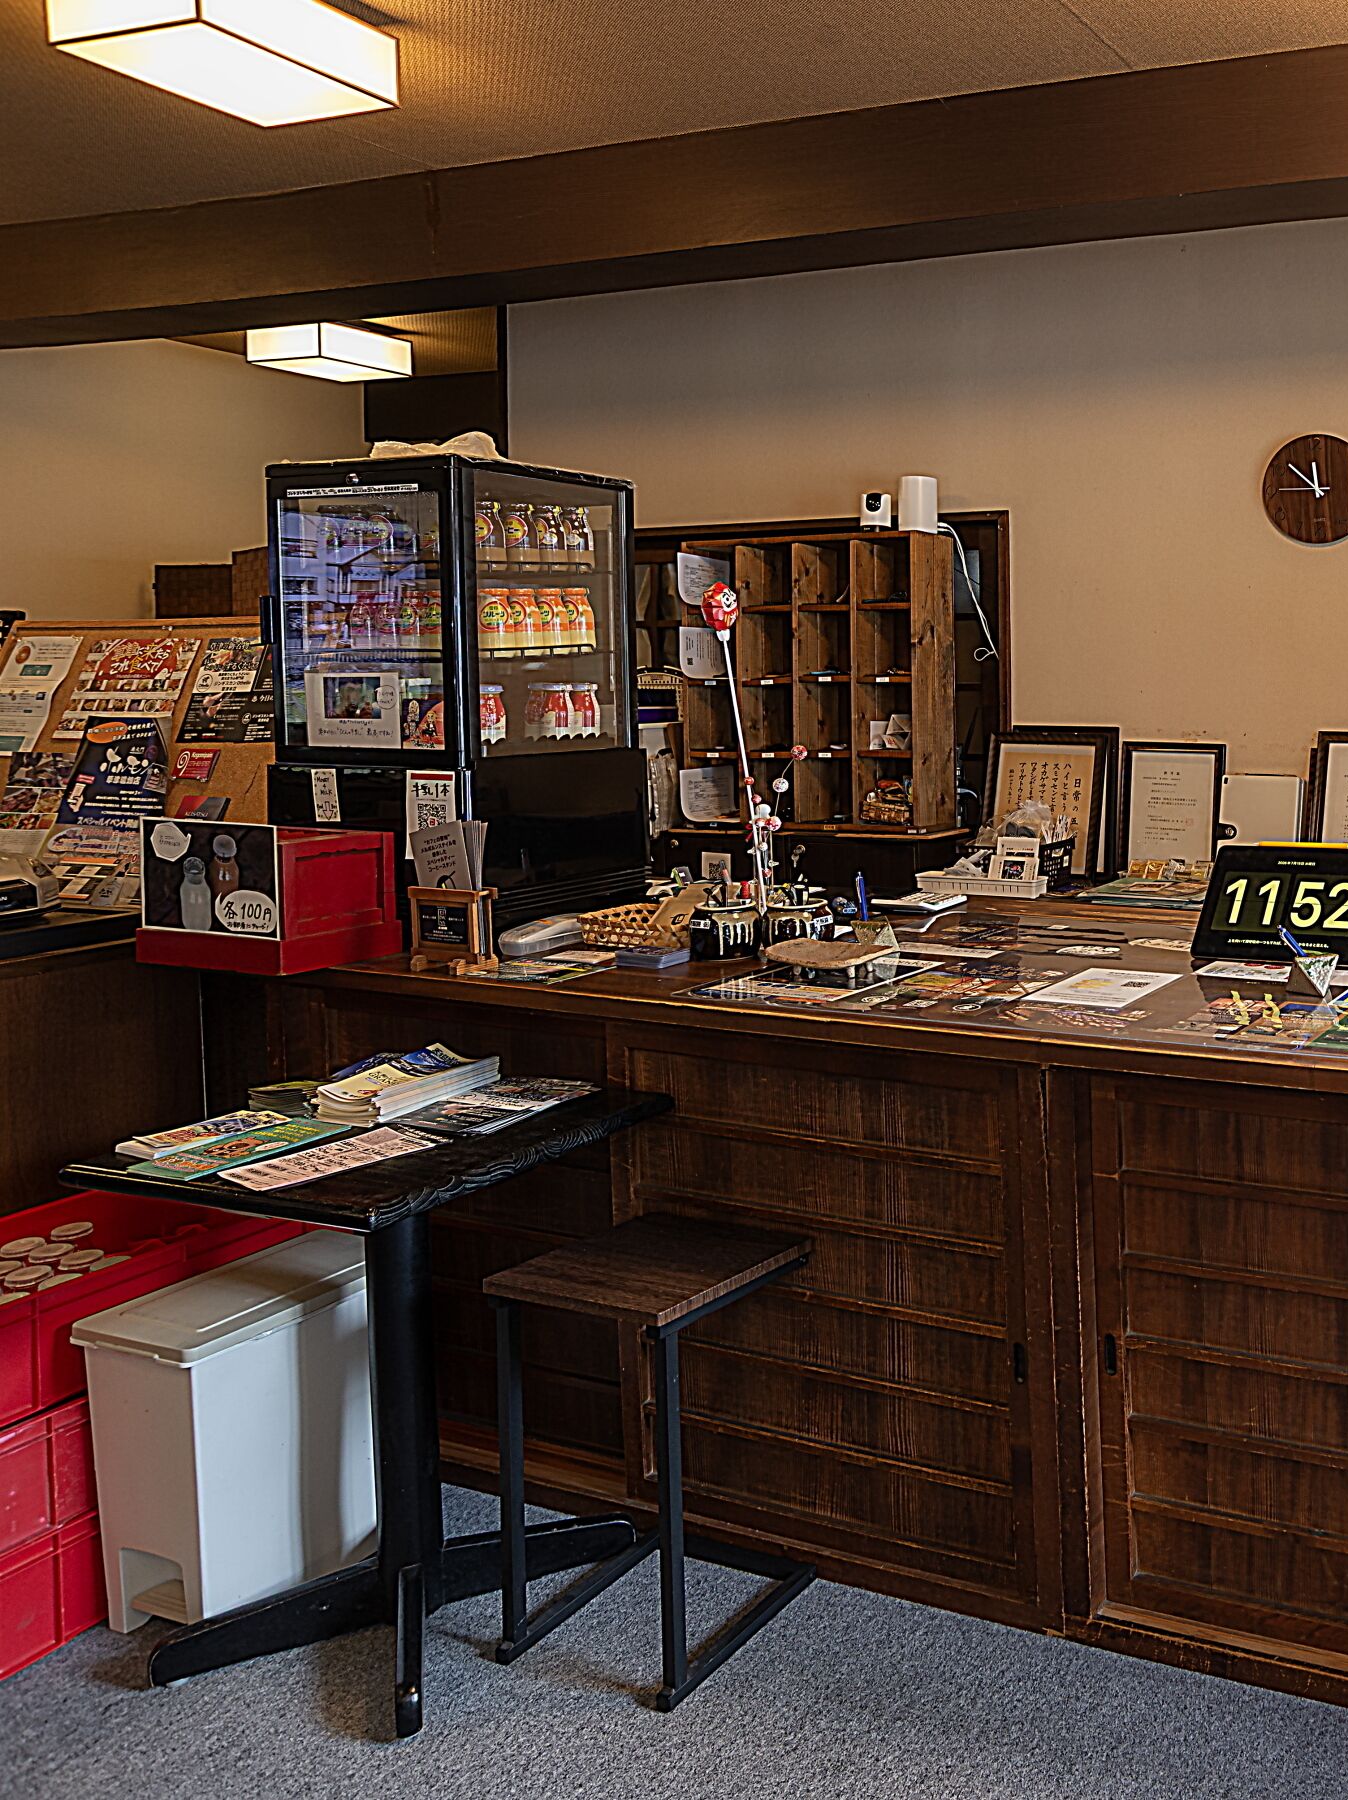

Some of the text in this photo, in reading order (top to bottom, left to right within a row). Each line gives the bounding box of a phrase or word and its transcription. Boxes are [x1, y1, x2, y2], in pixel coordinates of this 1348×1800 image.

[410, 781, 451, 798] 牛乳1本
[1049, 763, 1060, 815] スミマセンと言
